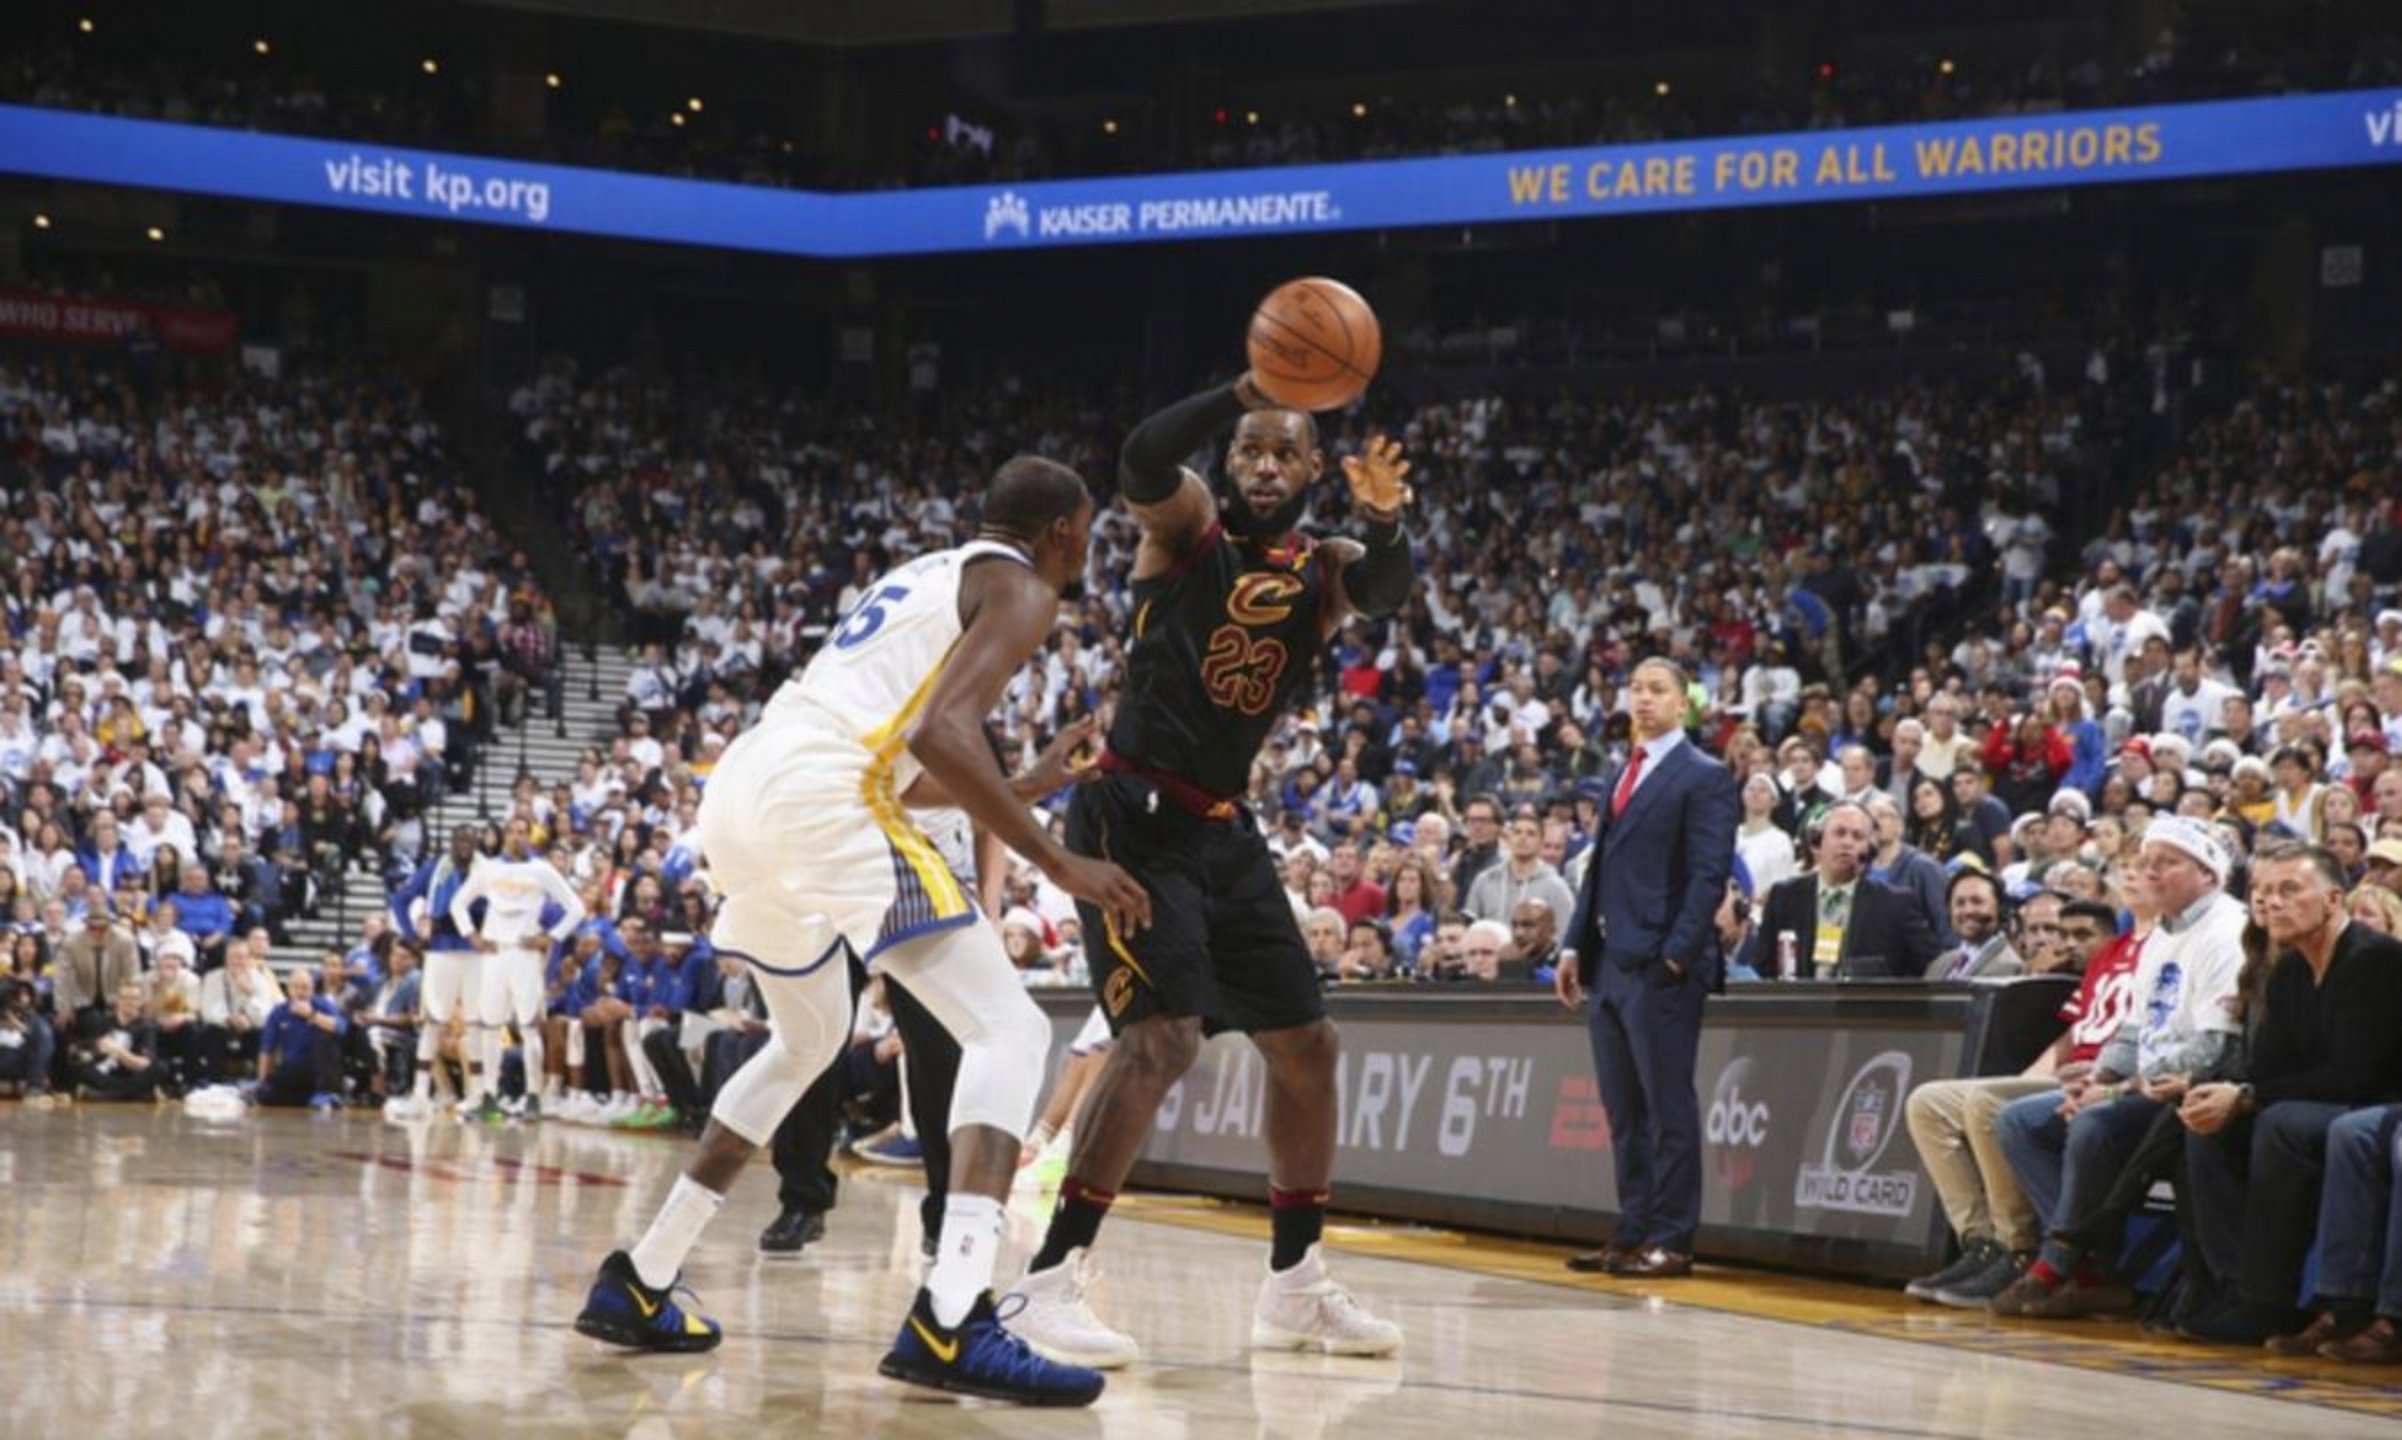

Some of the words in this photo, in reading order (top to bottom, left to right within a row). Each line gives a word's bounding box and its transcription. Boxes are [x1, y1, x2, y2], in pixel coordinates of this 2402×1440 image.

[325, 154, 413, 199] visit
[425, 163, 549, 222] kp.org
[1507, 163, 1571, 204] WE
[1586, 155, 1696, 199] CARE
[1714, 149, 1799, 191] FOR
[1815, 143, 1896, 186] ALL
[1915, 122, 2163, 179] WARRIORS
[1040, 202, 1131, 237] KAISER
[1226, 572, 1304, 625] C
[1202, 623, 1288, 716] 23
[1193, 1048, 1433, 1151] JARY
[1438, 1056, 1533, 1157] 6TH
[1706, 1085, 1770, 1147] abc
[1855, 1178, 1911, 1208] CARD
